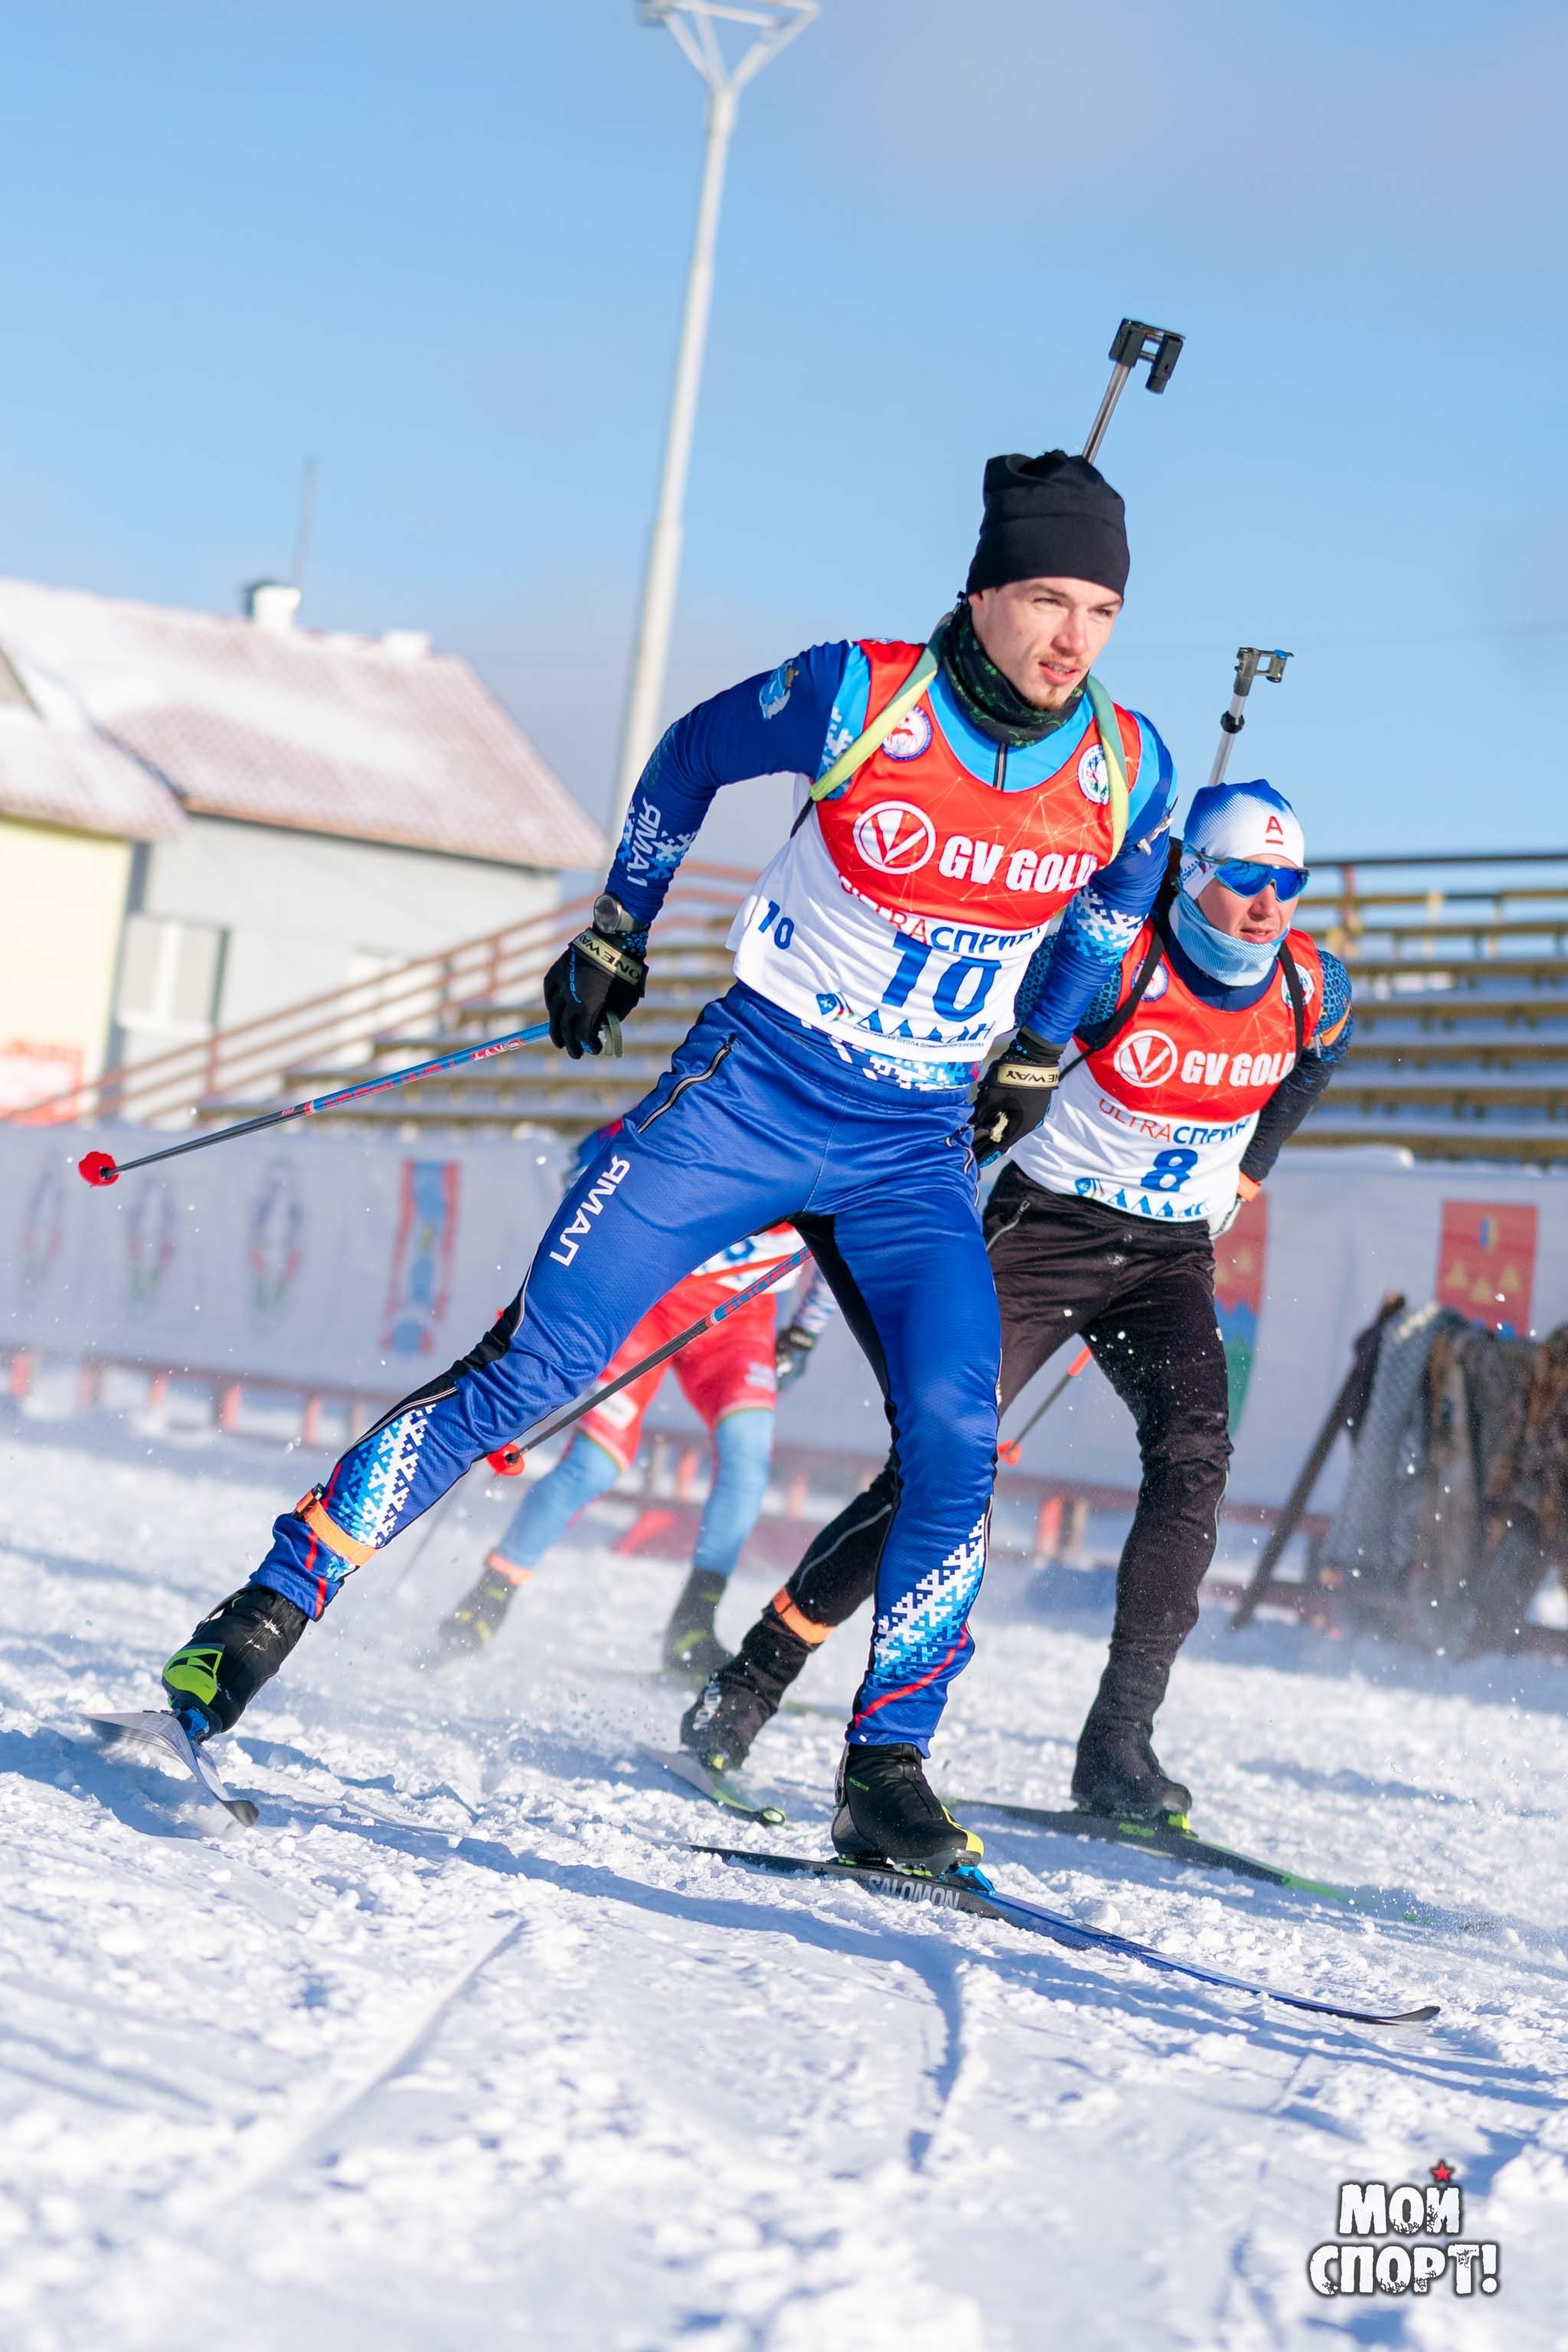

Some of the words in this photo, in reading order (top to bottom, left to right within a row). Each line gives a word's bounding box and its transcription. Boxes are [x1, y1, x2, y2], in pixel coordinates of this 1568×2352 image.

[938, 835, 1004, 885] GV
[1005, 849, 1098, 893] GOLD
[758, 900, 795, 950] 10
[881, 930, 1002, 1023] 10
[1181, 1050, 1229, 1086] GV
[1229, 1053, 1296, 1087] GOLD
[1140, 1148, 1198, 1192] 8
[549, 1155, 631, 1267] ЯМАЛ
[867, 1875, 960, 1909] SALOMON
